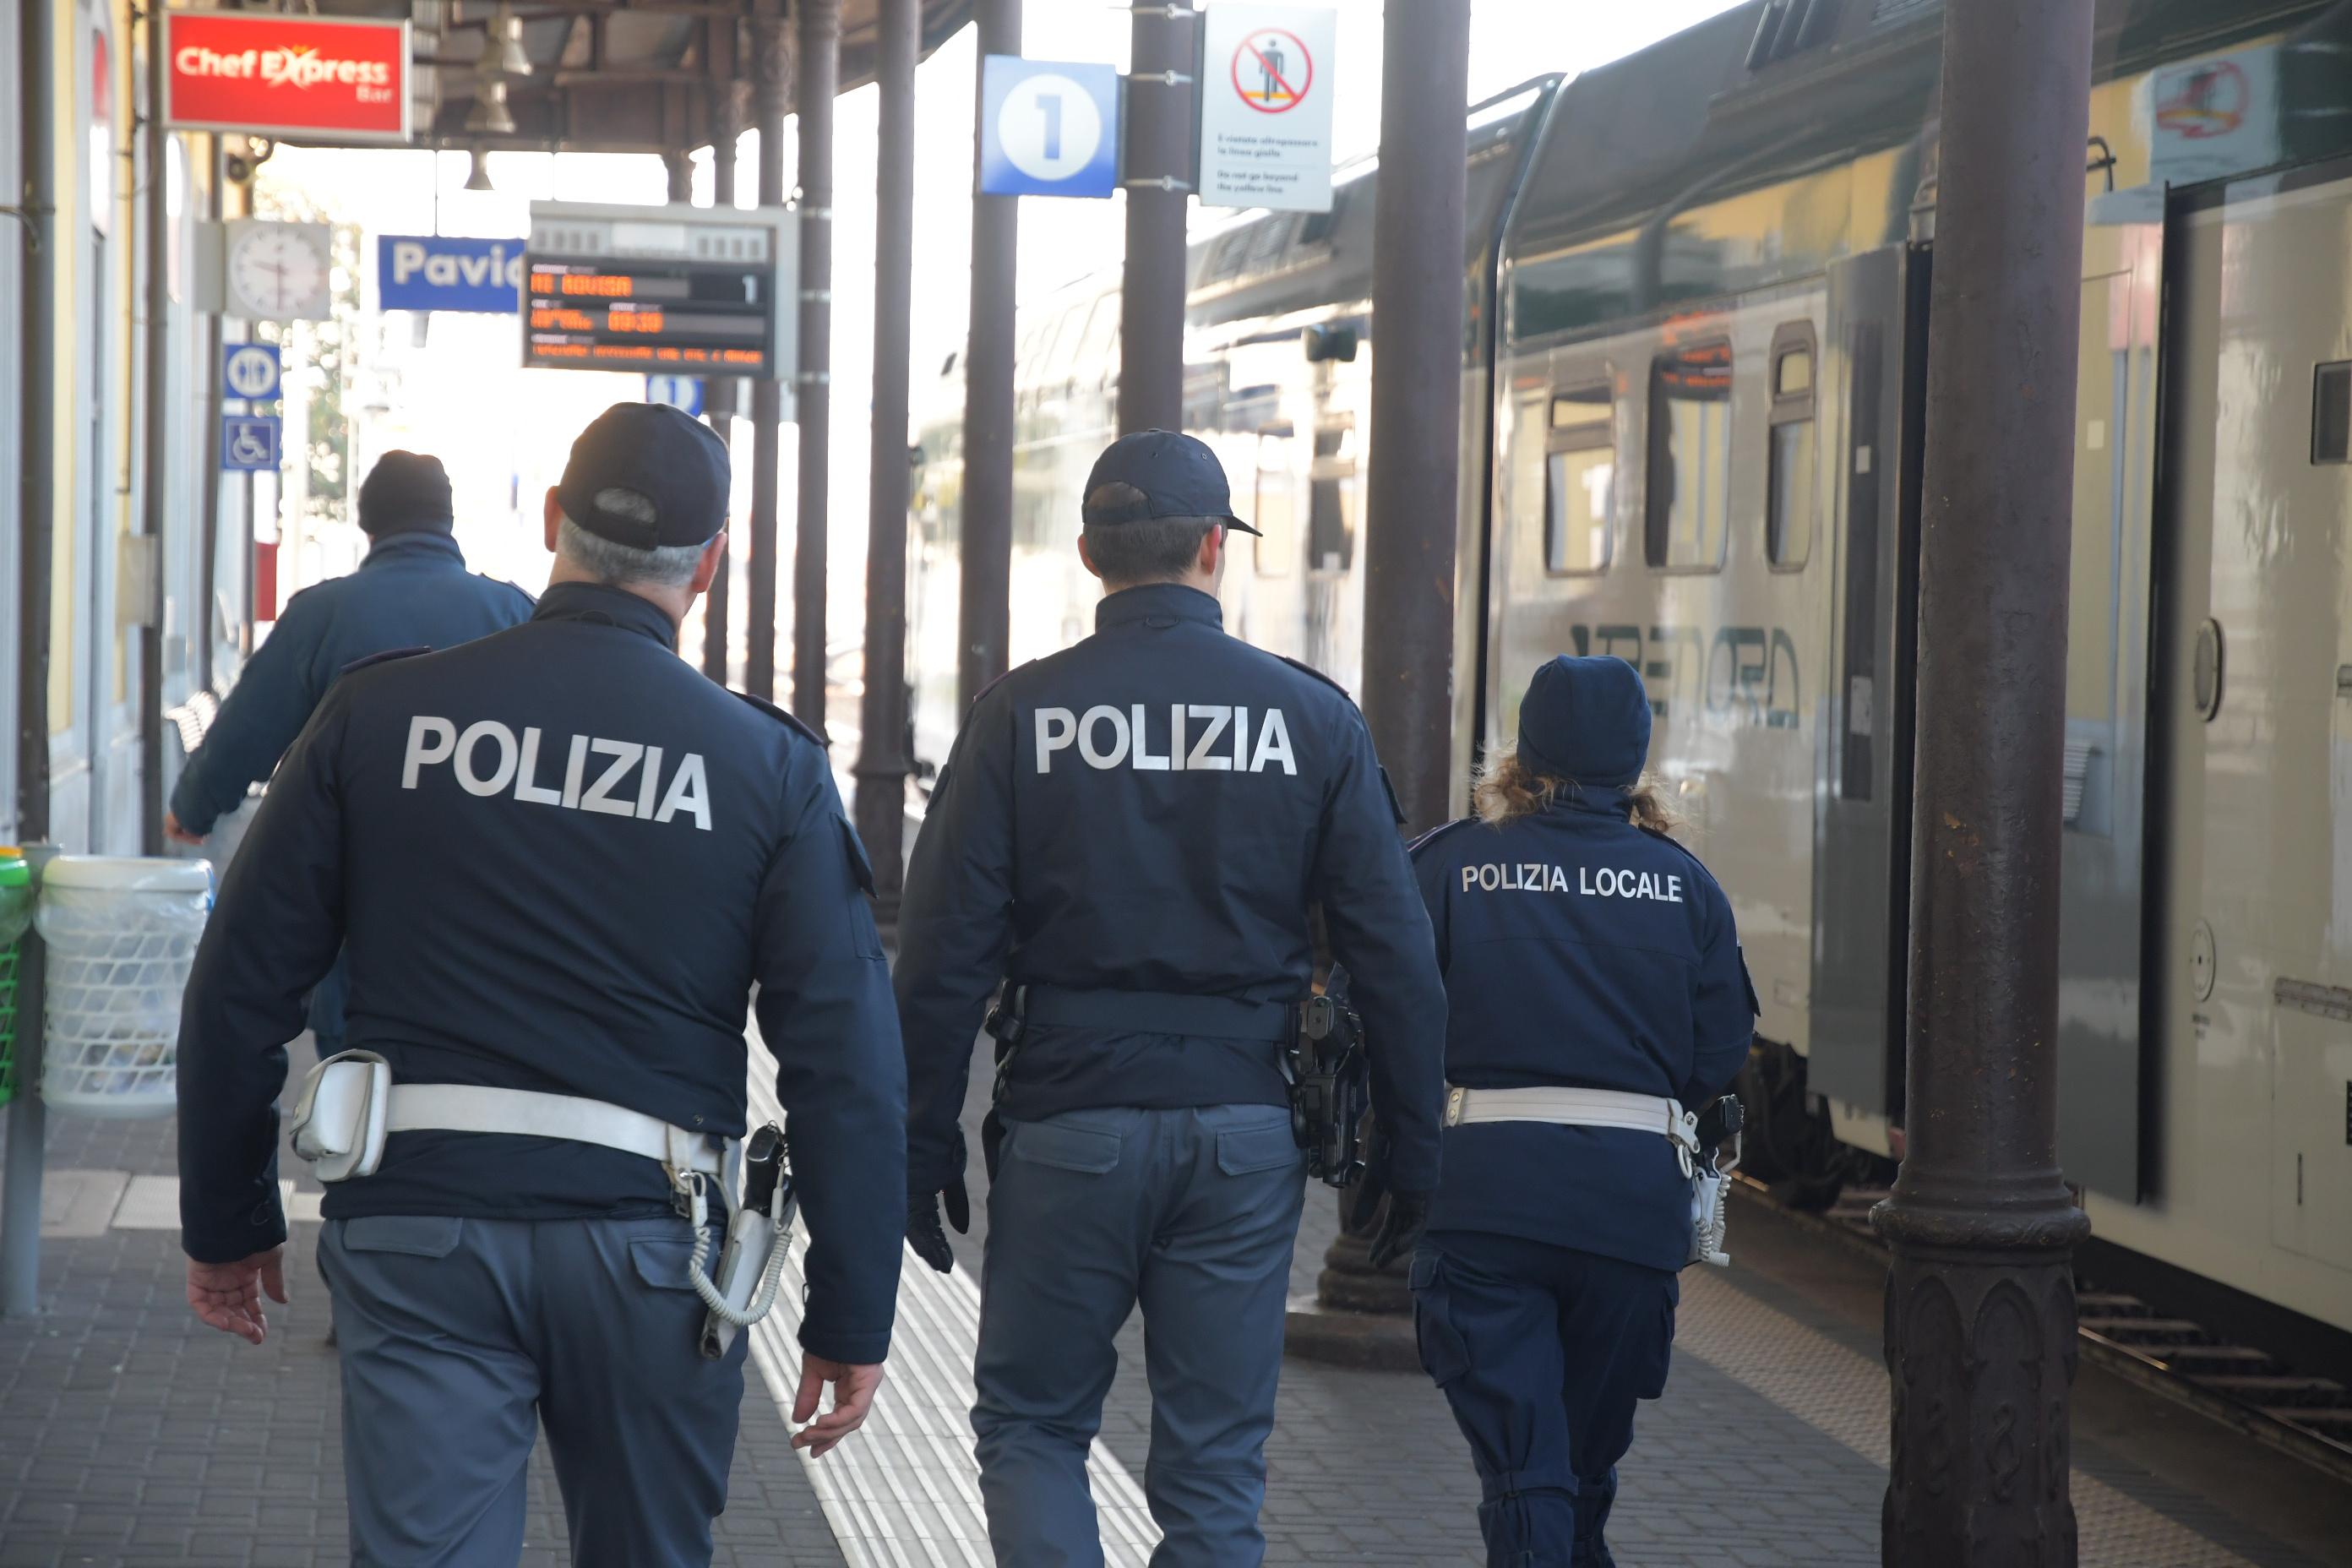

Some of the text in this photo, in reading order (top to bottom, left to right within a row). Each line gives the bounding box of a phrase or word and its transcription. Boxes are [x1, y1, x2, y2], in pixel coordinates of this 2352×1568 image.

[176, 46, 258, 79] Chef
[356, 85, 394, 103] Bar
[1036, 94, 1062, 161] 1
[1233, 183, 1265, 193] yellow
[1249, 172, 1260, 182] go
[1262, 172, 1298, 182] beyond
[743, 275, 759, 304] 1
[1035, 704, 1298, 776] POLIZIA
[401, 716, 712, 831] POLIZIA
[1462, 863, 1683, 903] POLIZIA LOCALE
